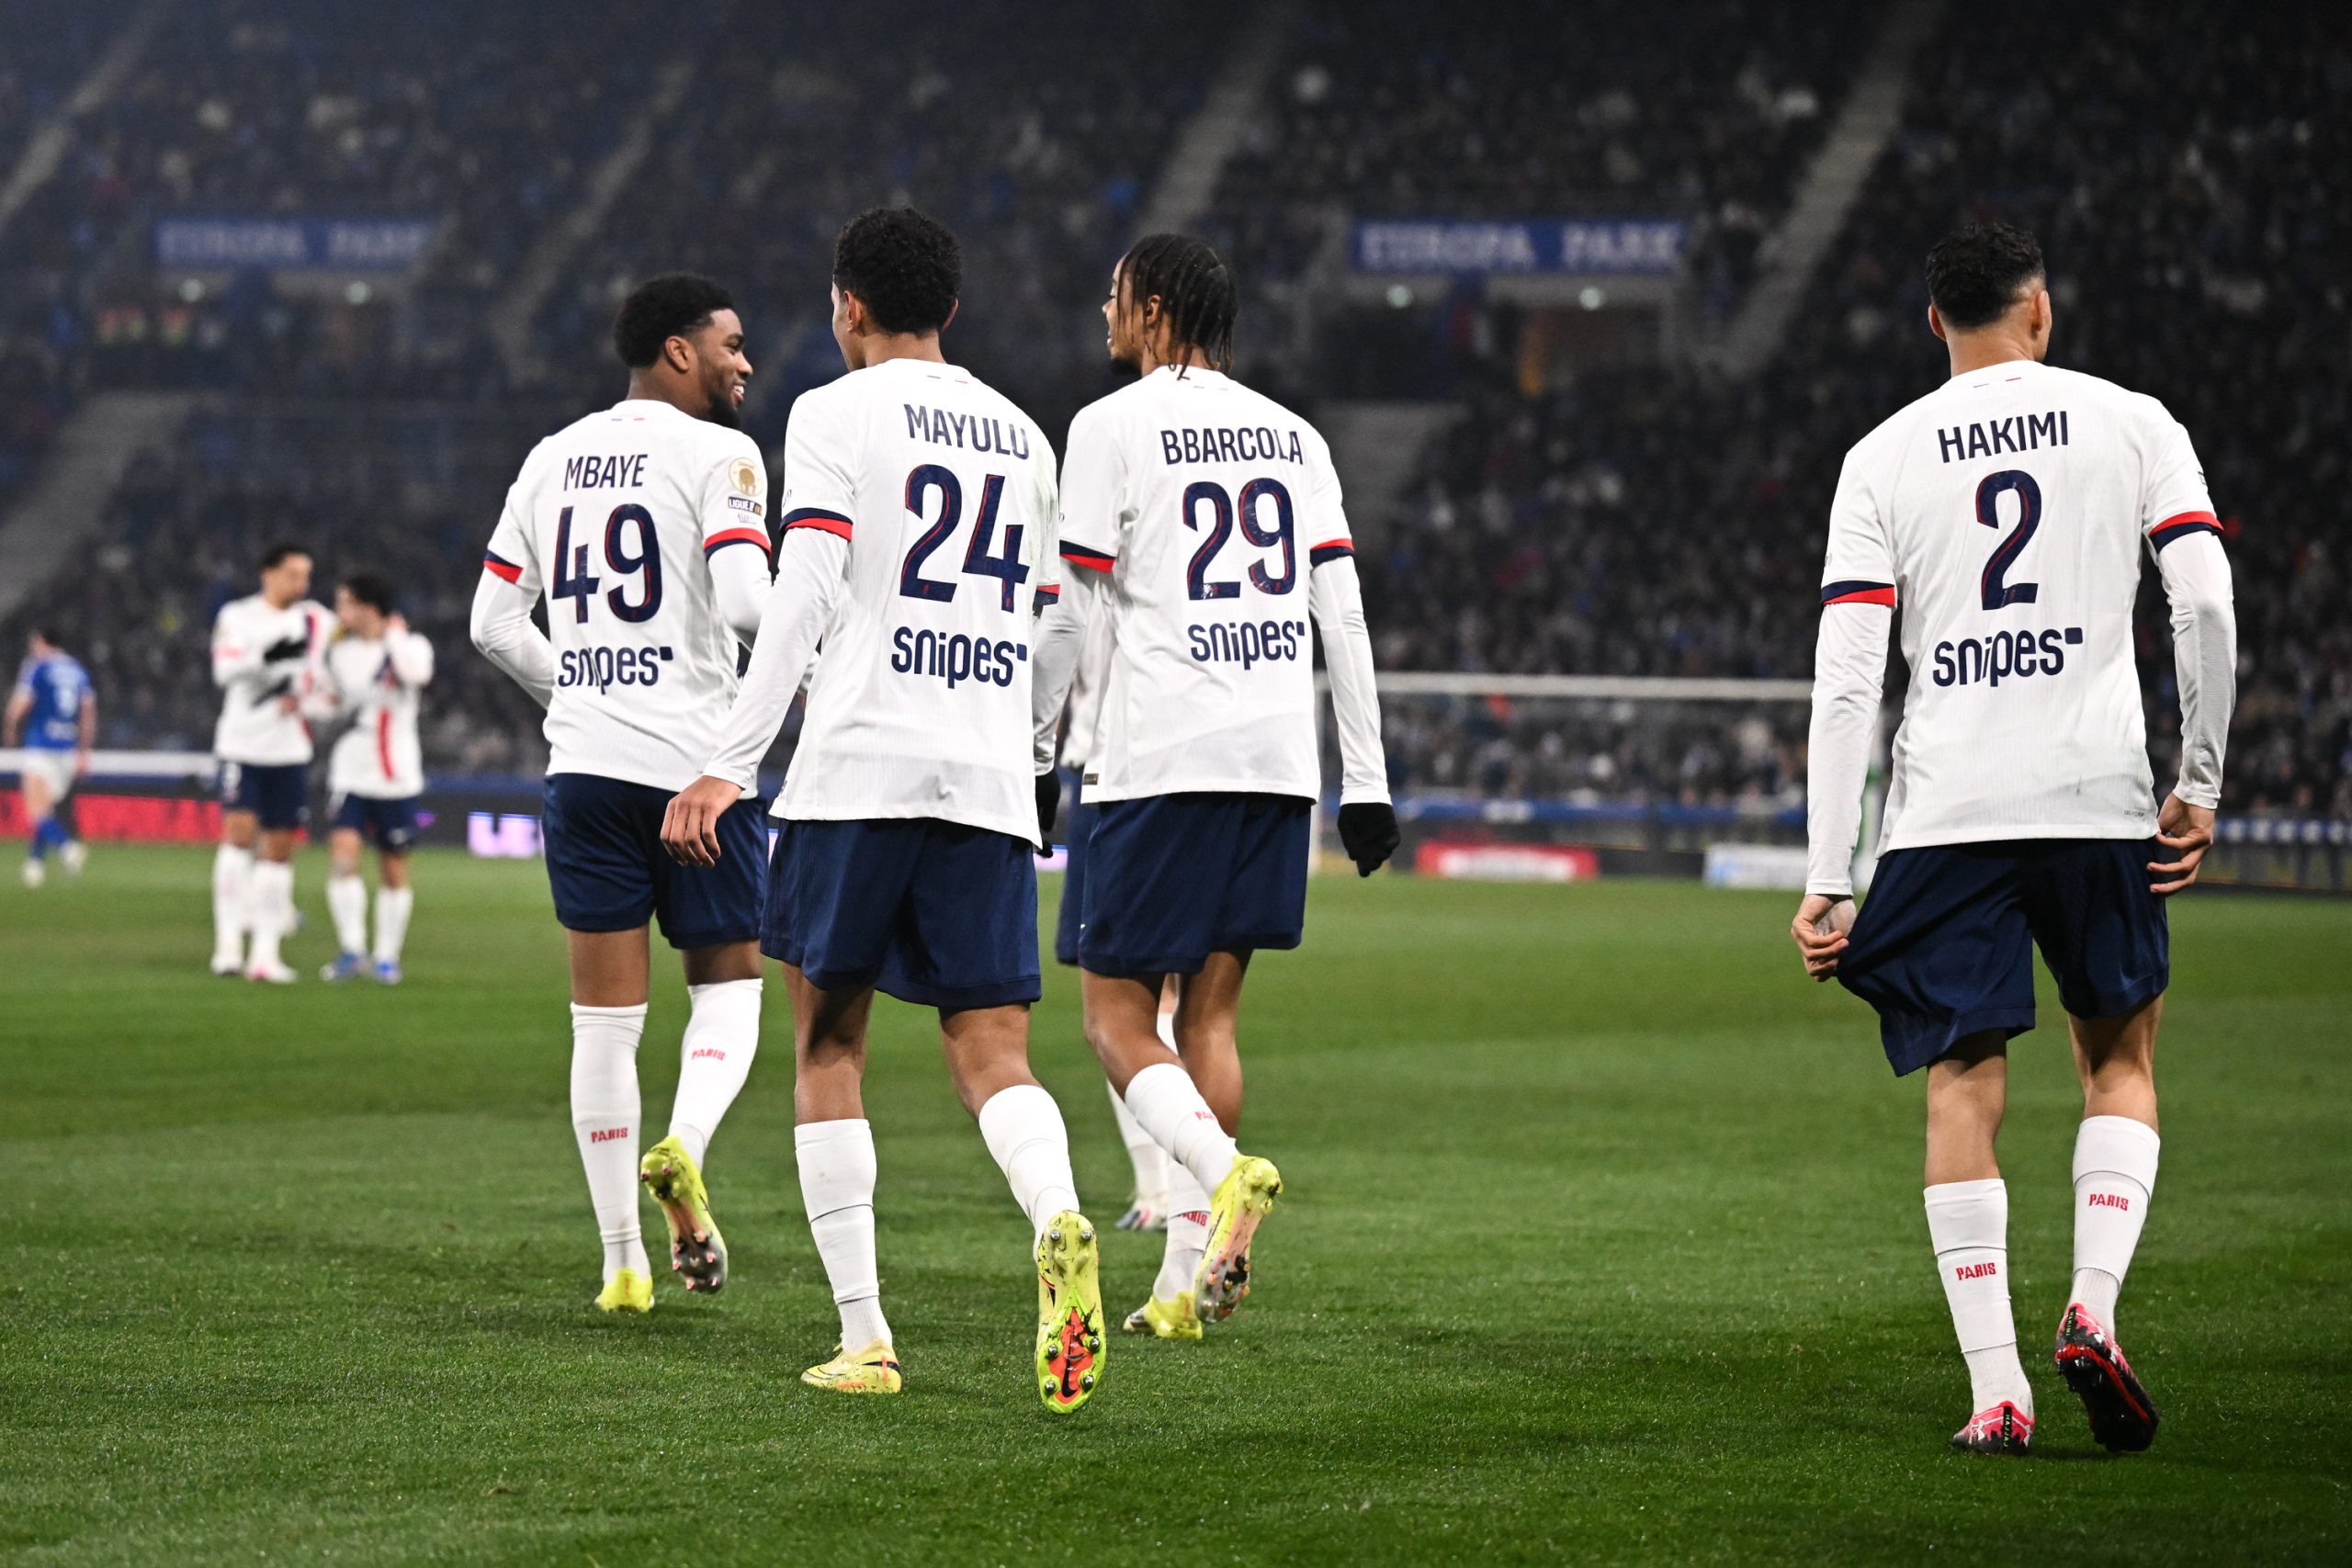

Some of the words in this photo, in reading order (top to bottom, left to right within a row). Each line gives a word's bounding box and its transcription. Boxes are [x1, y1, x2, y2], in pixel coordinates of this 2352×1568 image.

[1362, 223, 1535, 268] EUROPA
[903, 403, 1030, 460] MAYULU
[1160, 427, 1304, 465] BBARCOLA
[1937, 411, 2068, 463] HAKIMI
[563, 454, 648, 491] MBAYE
[552, 503, 662, 625] 49
[899, 464, 1030, 614] 24
[1182, 478, 1295, 601] 29
[1975, 469, 2041, 611] 2
[891, 626, 1015, 689] snipes
[1188, 620, 1297, 671] snipes
[1932, 628, 2064, 687] snipes
[691, 1048, 725, 1061] PARIS
[591, 1127, 628, 1144] PARIS
[1181, 1211, 1207, 1226] ARIS
[2088, 1193, 2129, 1211] PARIS
[1956, 1262, 1996, 1280] PARIS
